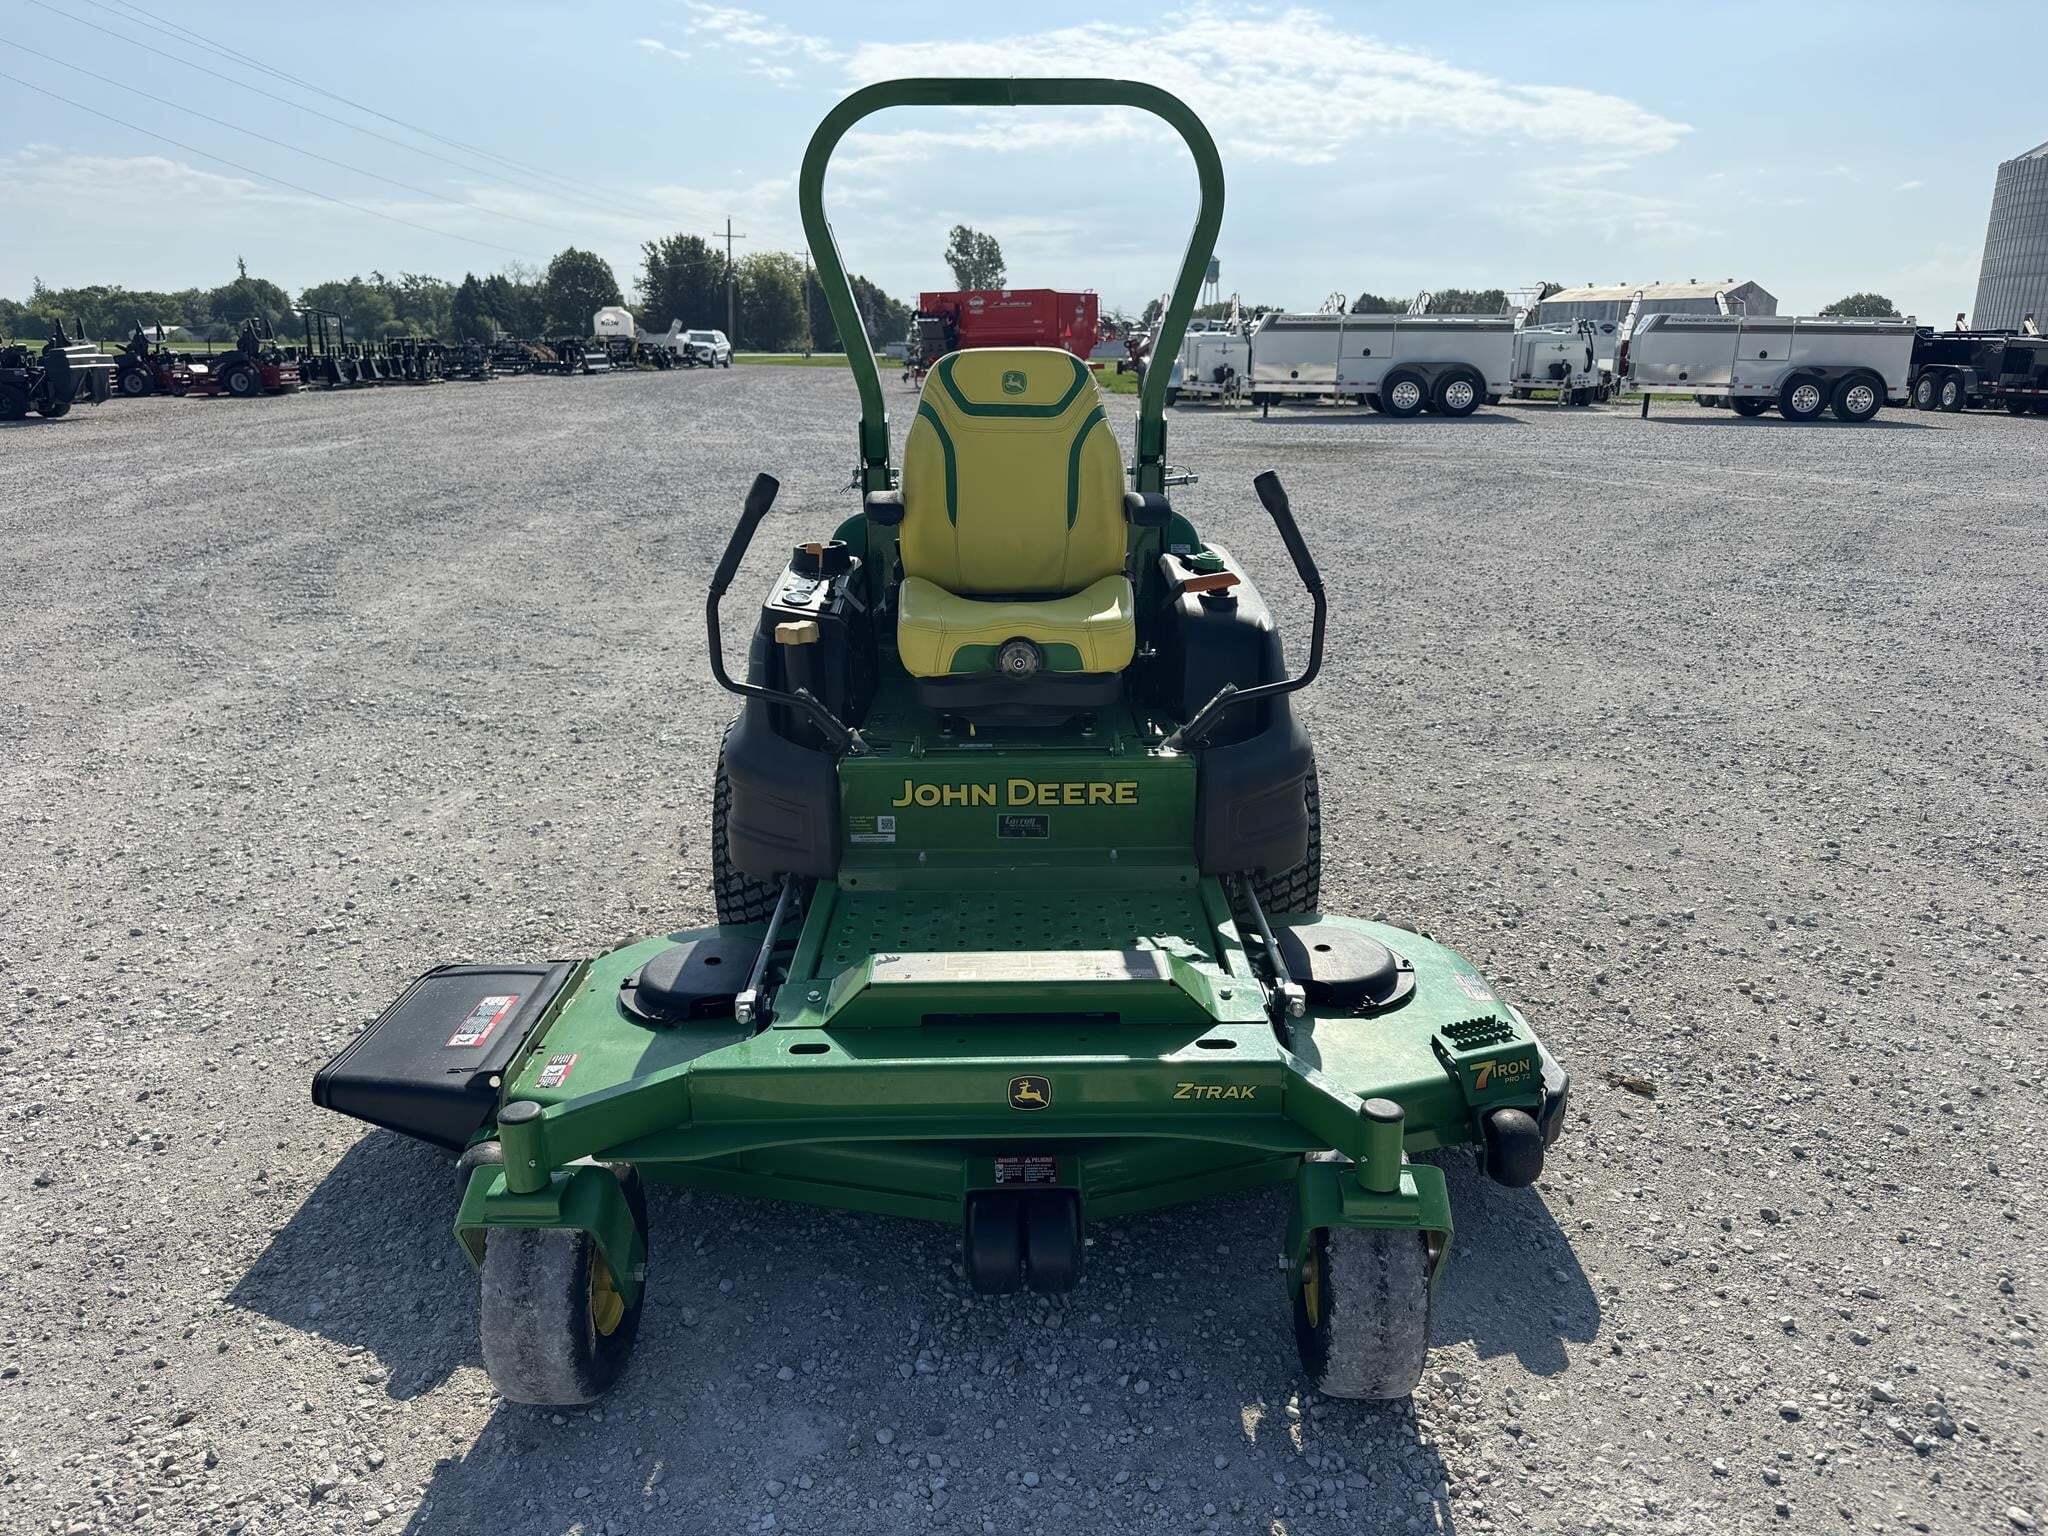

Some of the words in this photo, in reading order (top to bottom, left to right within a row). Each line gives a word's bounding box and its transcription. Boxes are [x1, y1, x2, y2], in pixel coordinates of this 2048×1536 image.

[892, 779, 997, 807] JOHN
[1007, 778, 1138, 806] DEERE
[1504, 1075, 1520, 1084] PRO
[1173, 1082, 1257, 1099] ZTRAK
